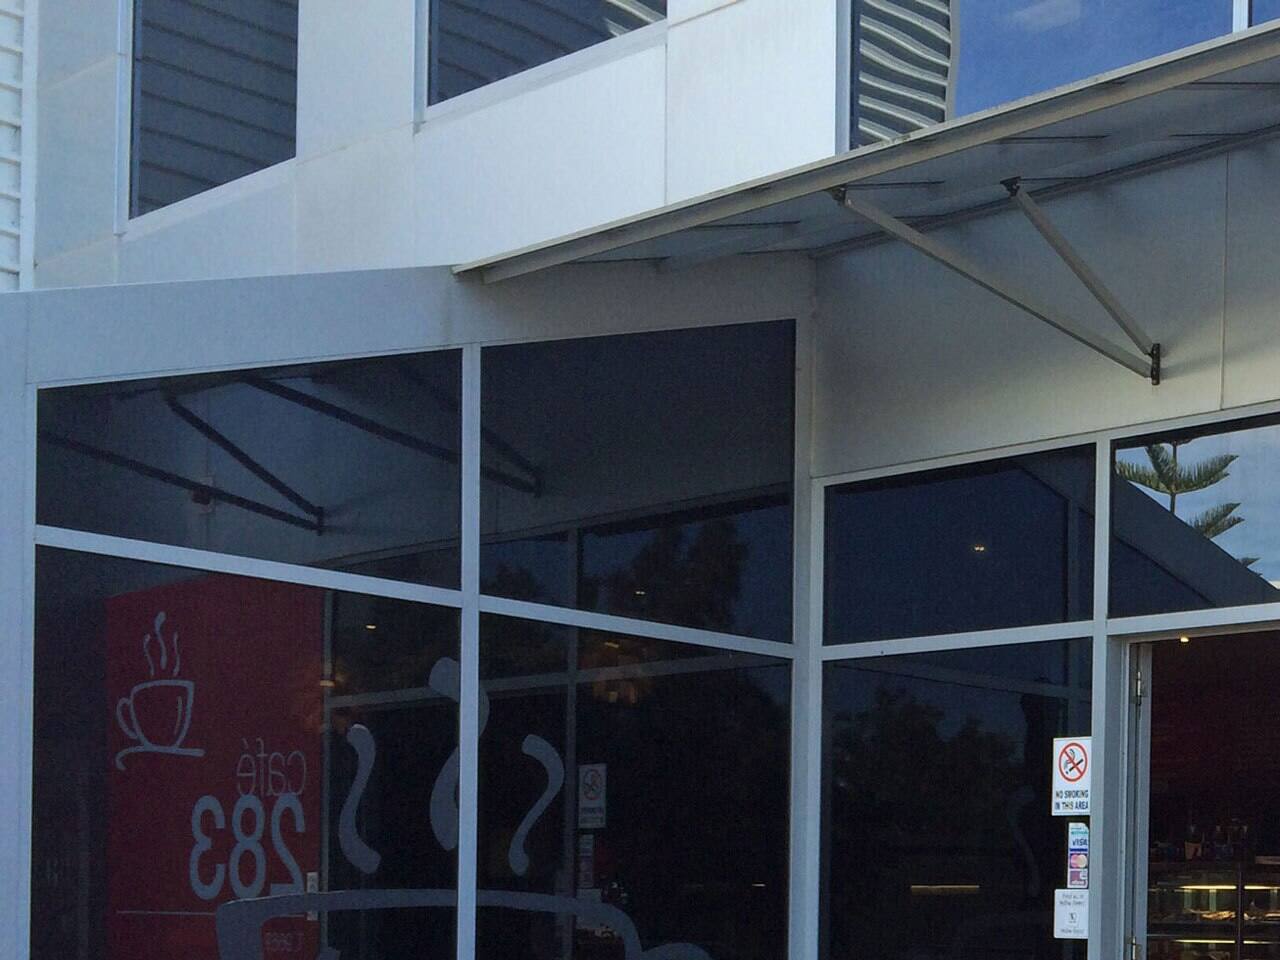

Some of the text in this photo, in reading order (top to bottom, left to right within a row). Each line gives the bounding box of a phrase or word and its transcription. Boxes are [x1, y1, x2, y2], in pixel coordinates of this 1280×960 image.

[1056, 789, 1088, 799] NO SMOKING
[1062, 801, 1073, 810] THIS
[1075, 800, 1088, 810] AREA
[1072, 838, 1088, 846] VISA
